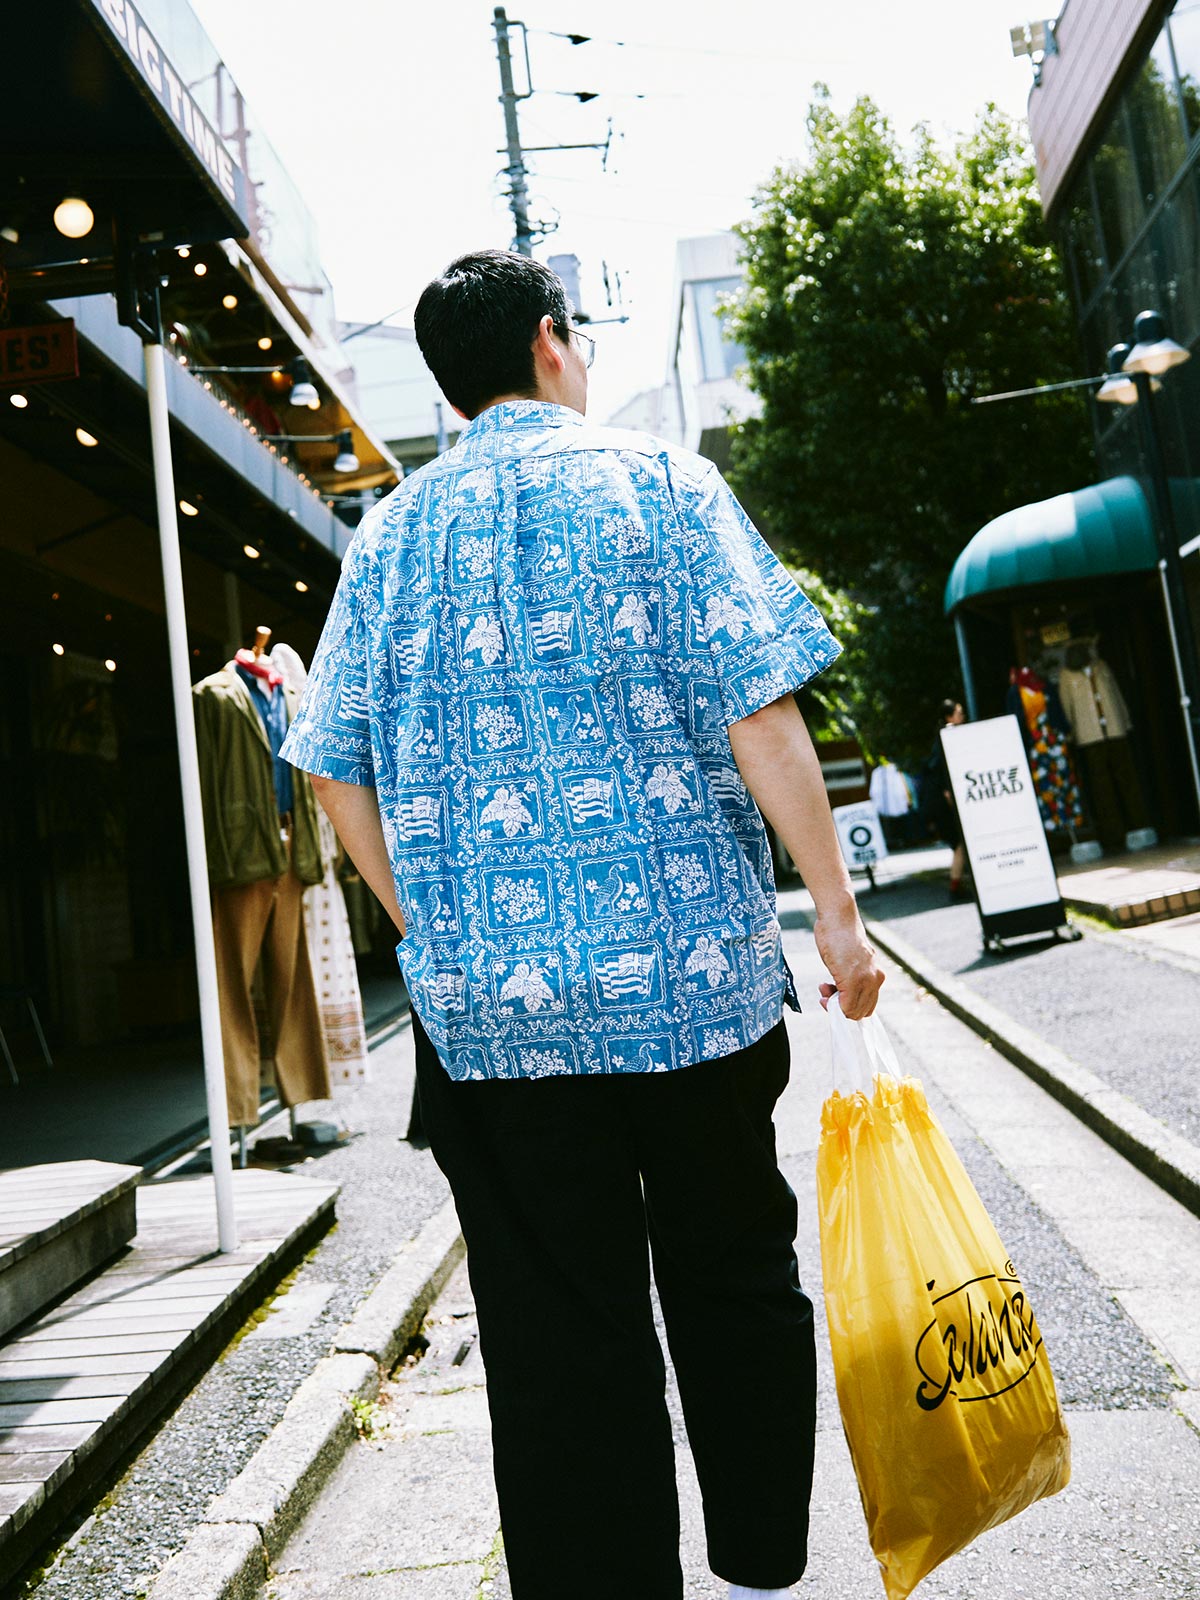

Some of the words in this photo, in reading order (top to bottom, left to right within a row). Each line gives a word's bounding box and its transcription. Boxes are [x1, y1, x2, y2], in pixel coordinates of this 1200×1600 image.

[163, 61, 236, 202] TIME
[0, 333, 61, 376] ES'
[964, 769, 1006, 787] STEP
[965, 779, 1024, 803] AHEAD
